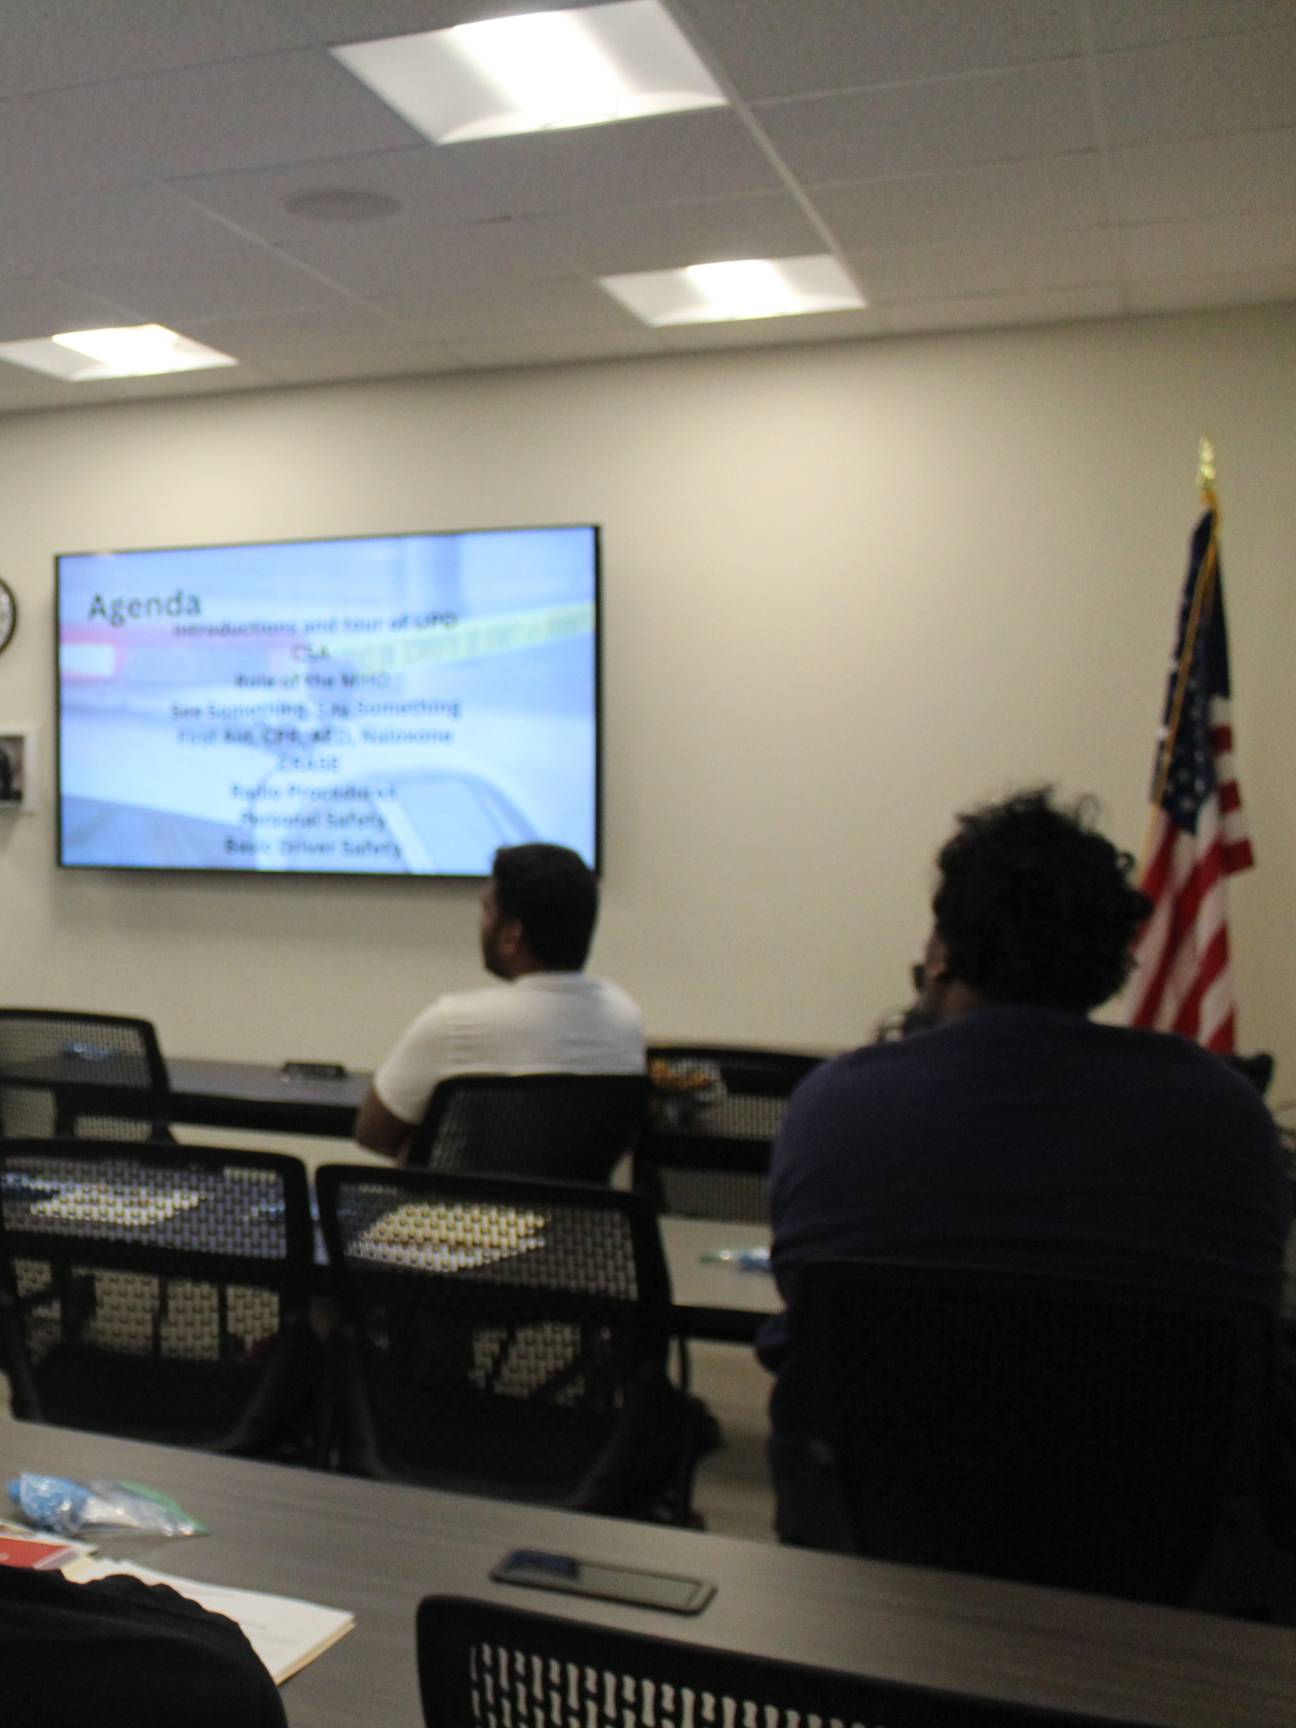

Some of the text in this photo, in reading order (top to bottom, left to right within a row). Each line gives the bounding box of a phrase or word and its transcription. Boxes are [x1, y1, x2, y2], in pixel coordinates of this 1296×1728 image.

[89, 591, 202, 628] Agenda
[172, 620, 296, 637] Introductions
[304, 615, 338, 634] and
[344, 615, 383, 633] tour
[391, 612, 408, 631] of
[281, 673, 301, 689] of
[305, 674, 334, 690] the
[171, 704, 201, 719] See
[357, 701, 462, 720] Something
[327, 811, 385, 832] Safety
[342, 839, 402, 860] Safety
